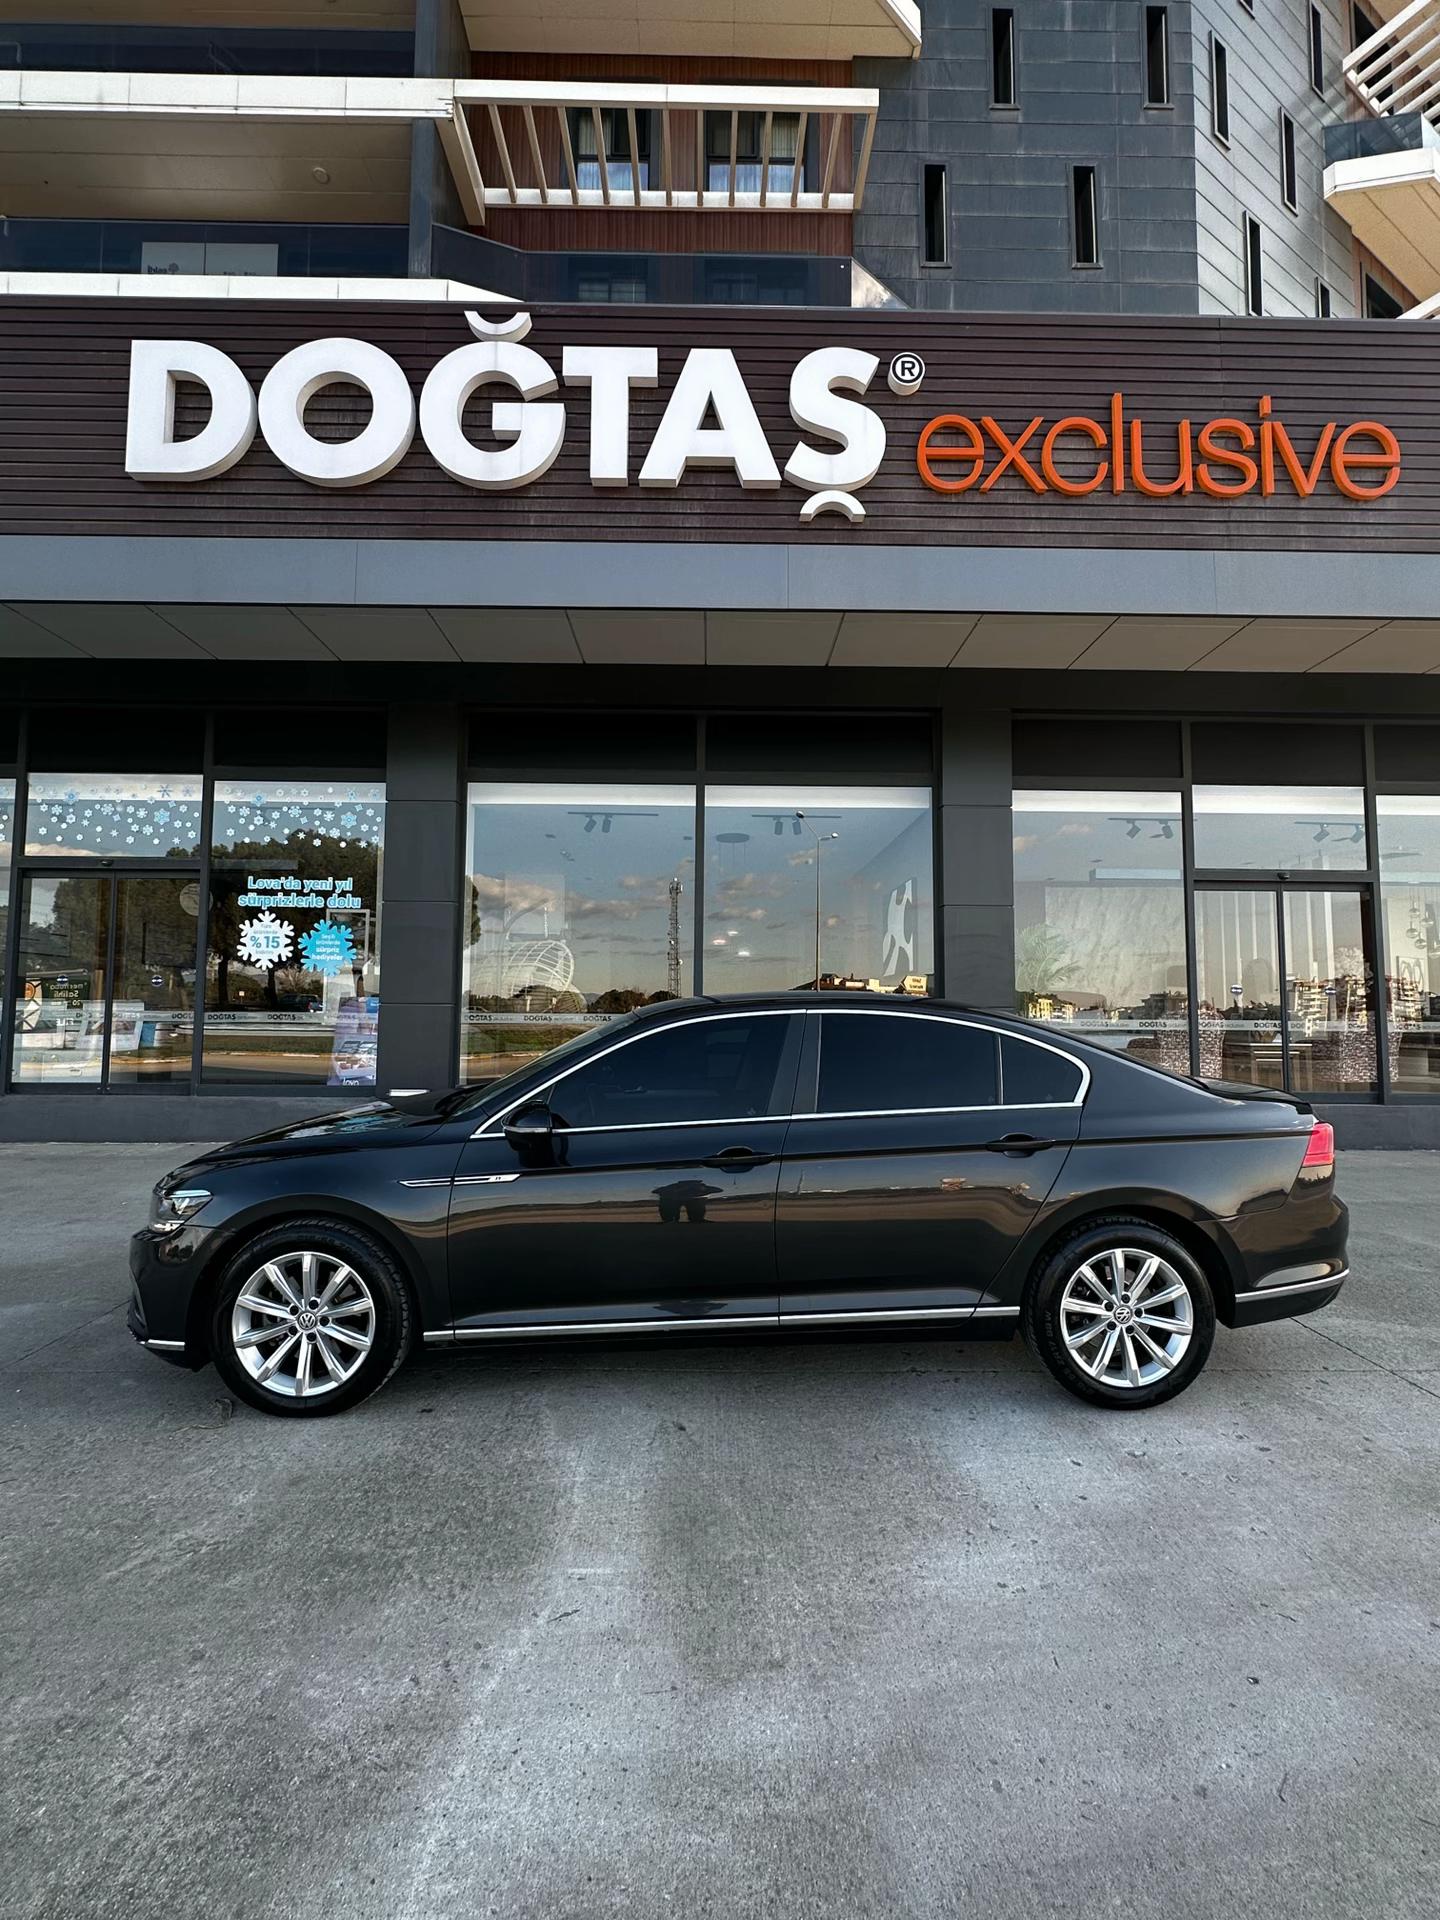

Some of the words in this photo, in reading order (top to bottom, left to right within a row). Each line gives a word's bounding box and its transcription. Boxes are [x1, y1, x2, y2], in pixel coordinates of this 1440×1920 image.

[125, 310, 887, 523] DOĞTAŞ
[916, 392, 1401, 500] exclusive
[247, 876, 301, 890] Lova'da
[303, 877, 333, 892] yeni
[335, 877, 353, 894] yıl
[238, 892, 325, 910] sürprizlerle
[327, 893, 362, 909] dolu
